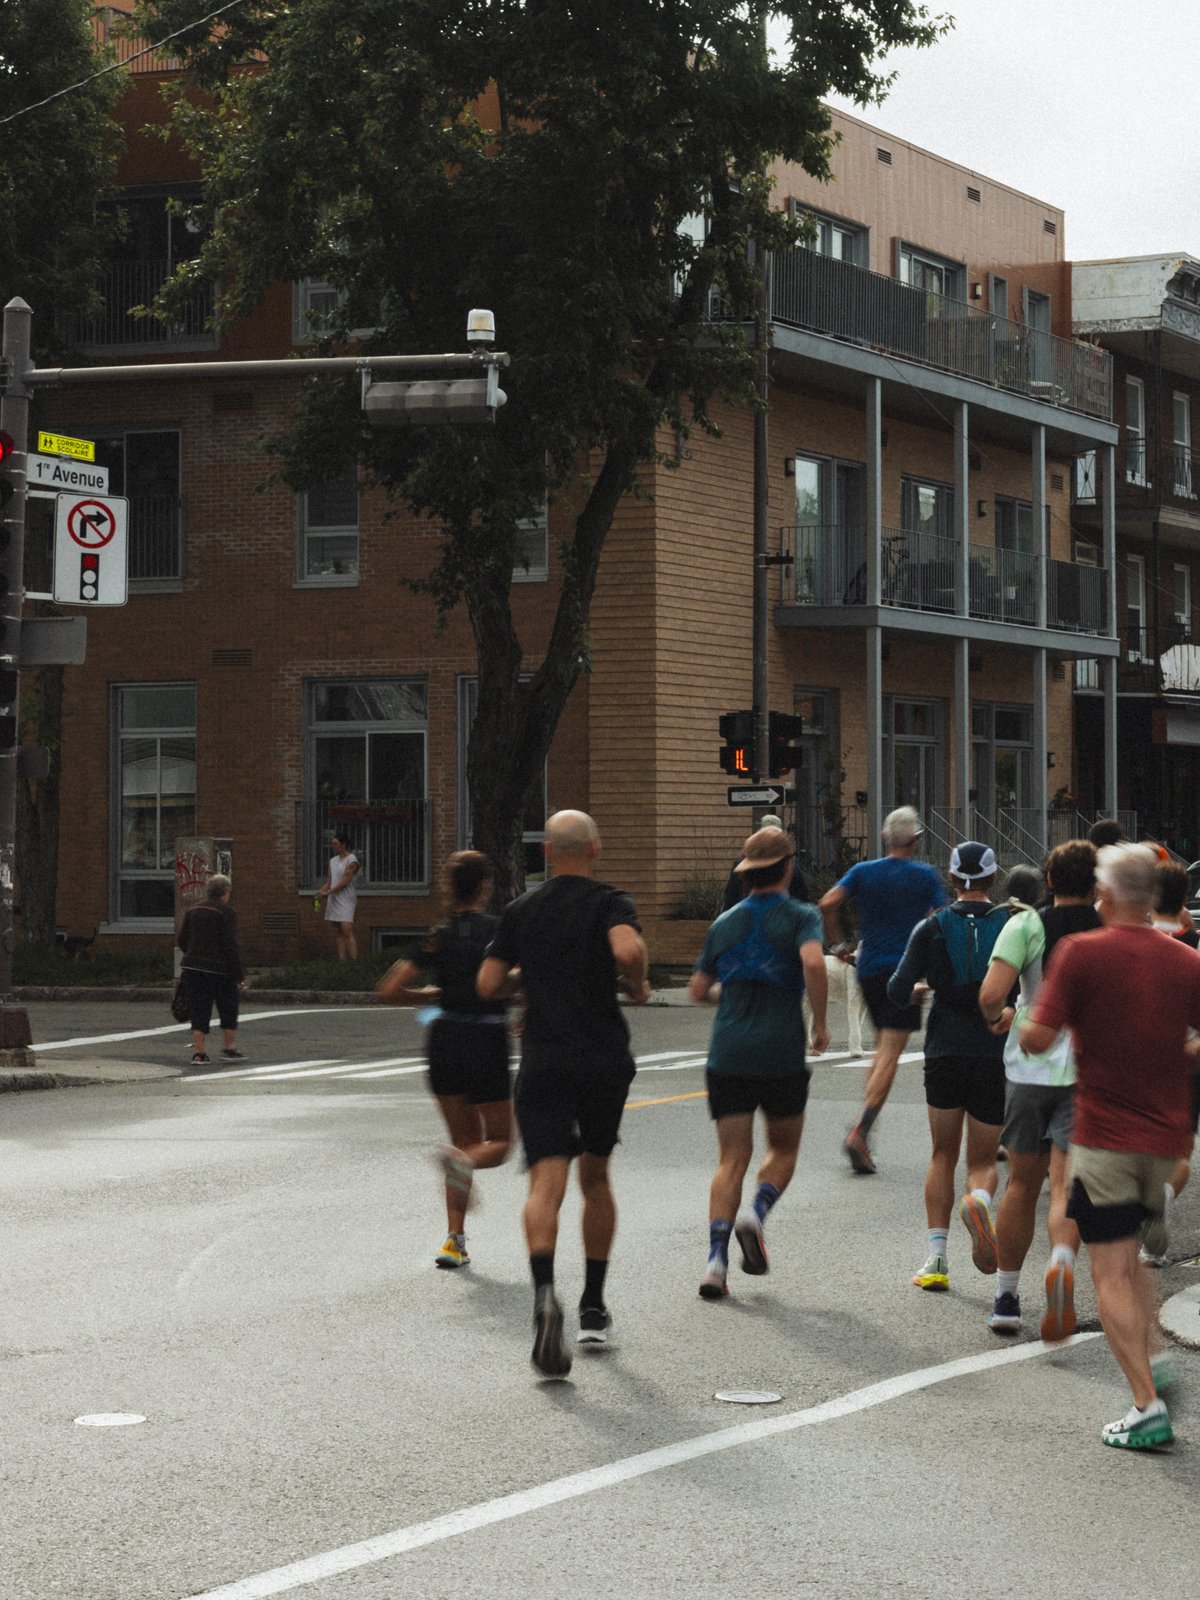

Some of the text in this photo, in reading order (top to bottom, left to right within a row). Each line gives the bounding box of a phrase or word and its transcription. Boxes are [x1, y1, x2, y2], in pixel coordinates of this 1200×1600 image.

[56, 438, 90, 450] CORRIDOR
[57, 446, 90, 457] SCOLAIRE
[52, 465, 104, 489] Avenue
